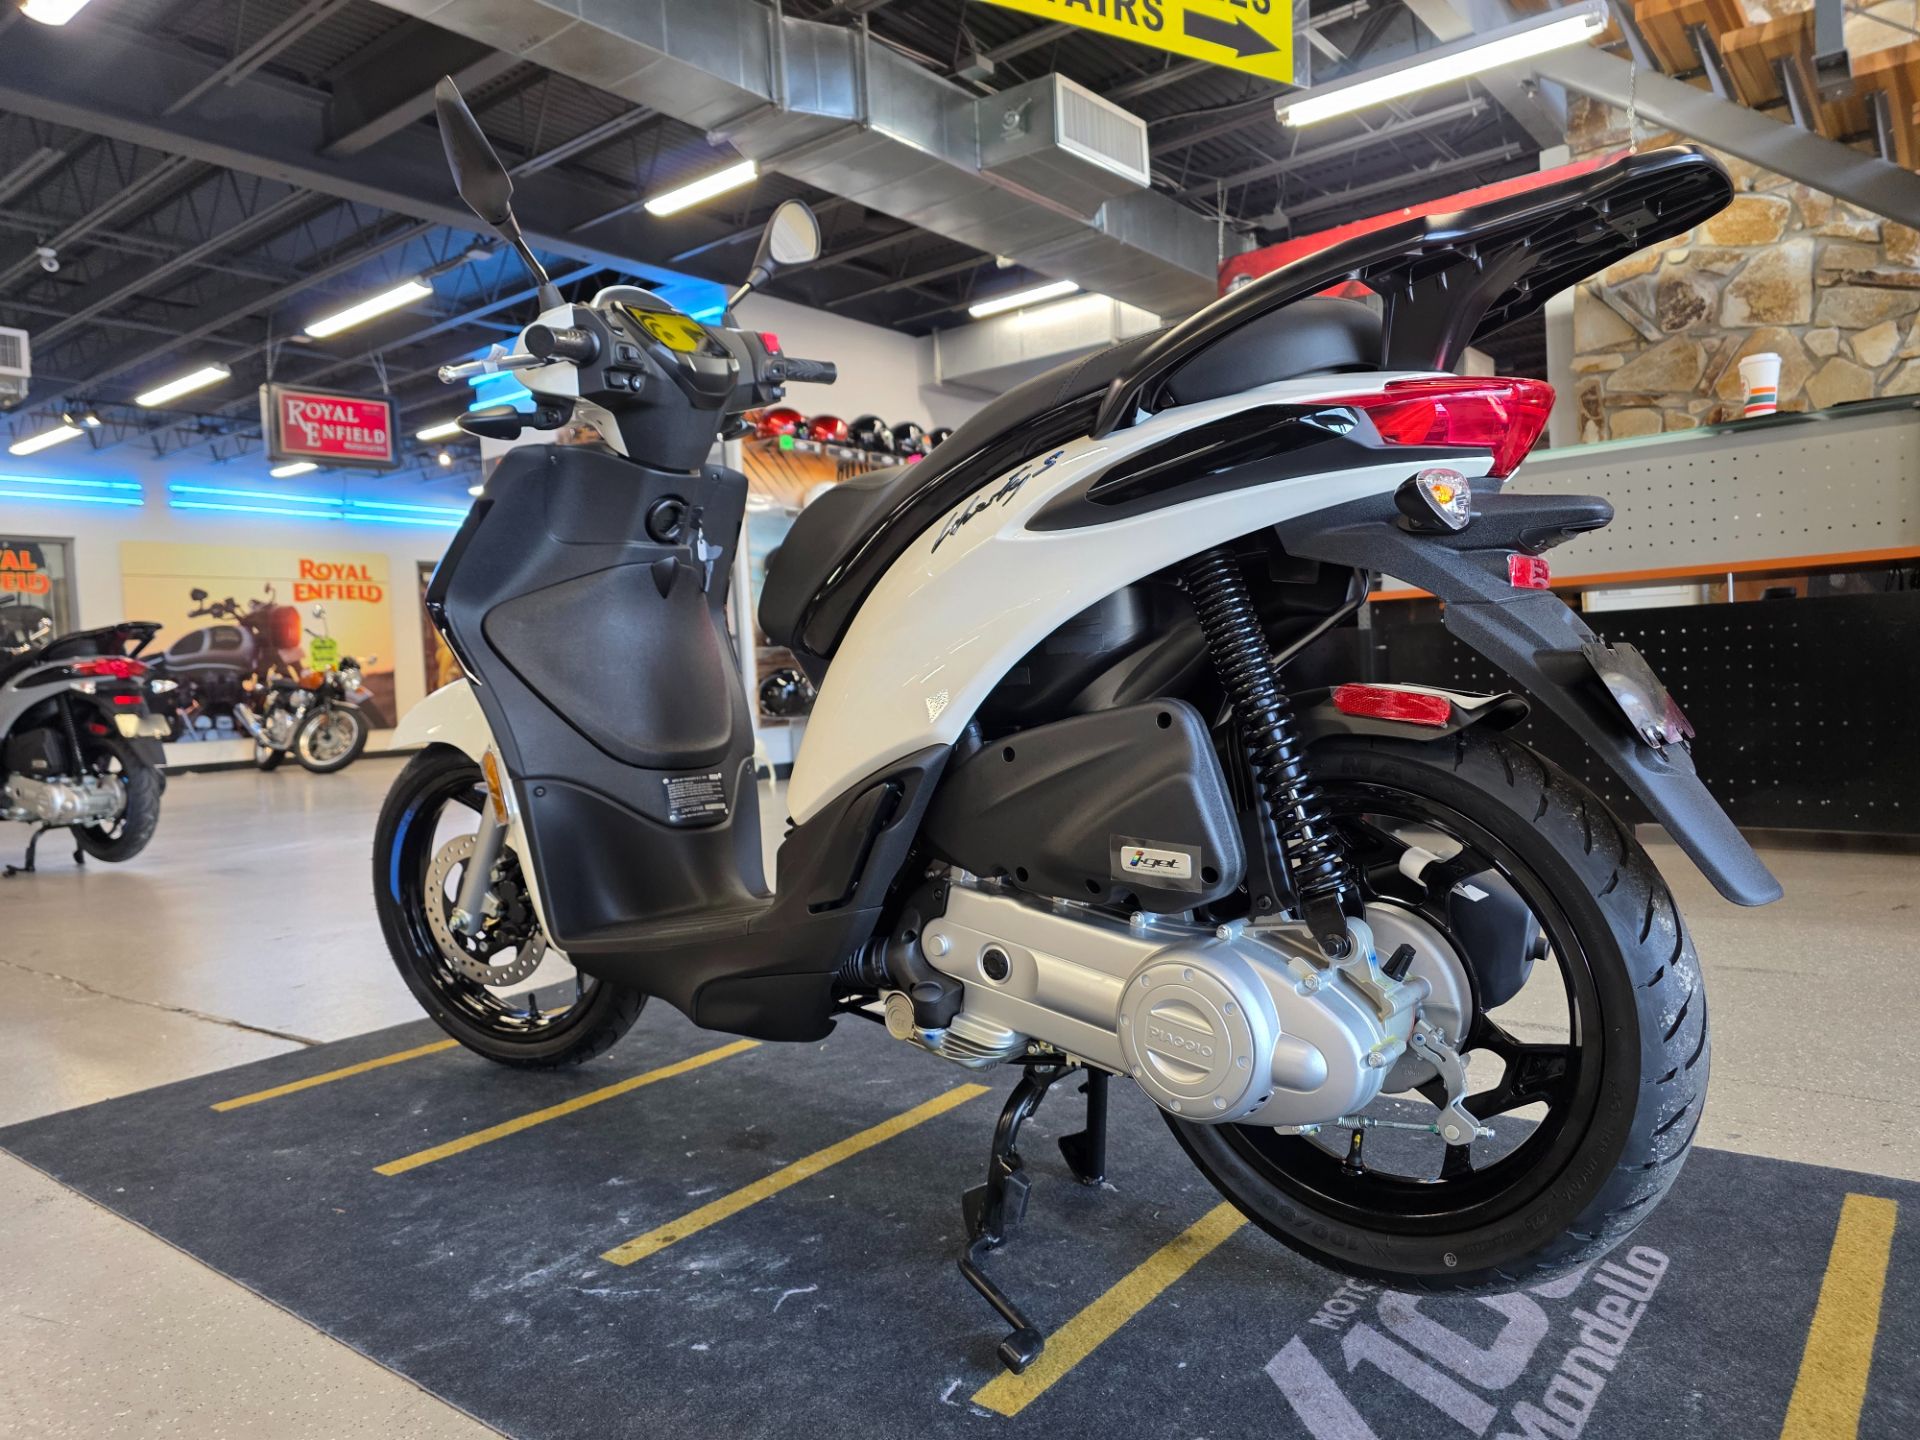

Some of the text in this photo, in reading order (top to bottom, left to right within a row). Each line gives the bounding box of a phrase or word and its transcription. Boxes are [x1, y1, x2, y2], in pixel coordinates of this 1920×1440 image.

[286, 400, 359, 425] ROYAL
[305, 422, 386, 447] ENFIELD
[0, 549, 38, 571] AL
[298, 558, 371, 580] ROYAL
[293, 582, 383, 603] ENFIELD
[1149, 1025, 1213, 1057] PIAGGIO
